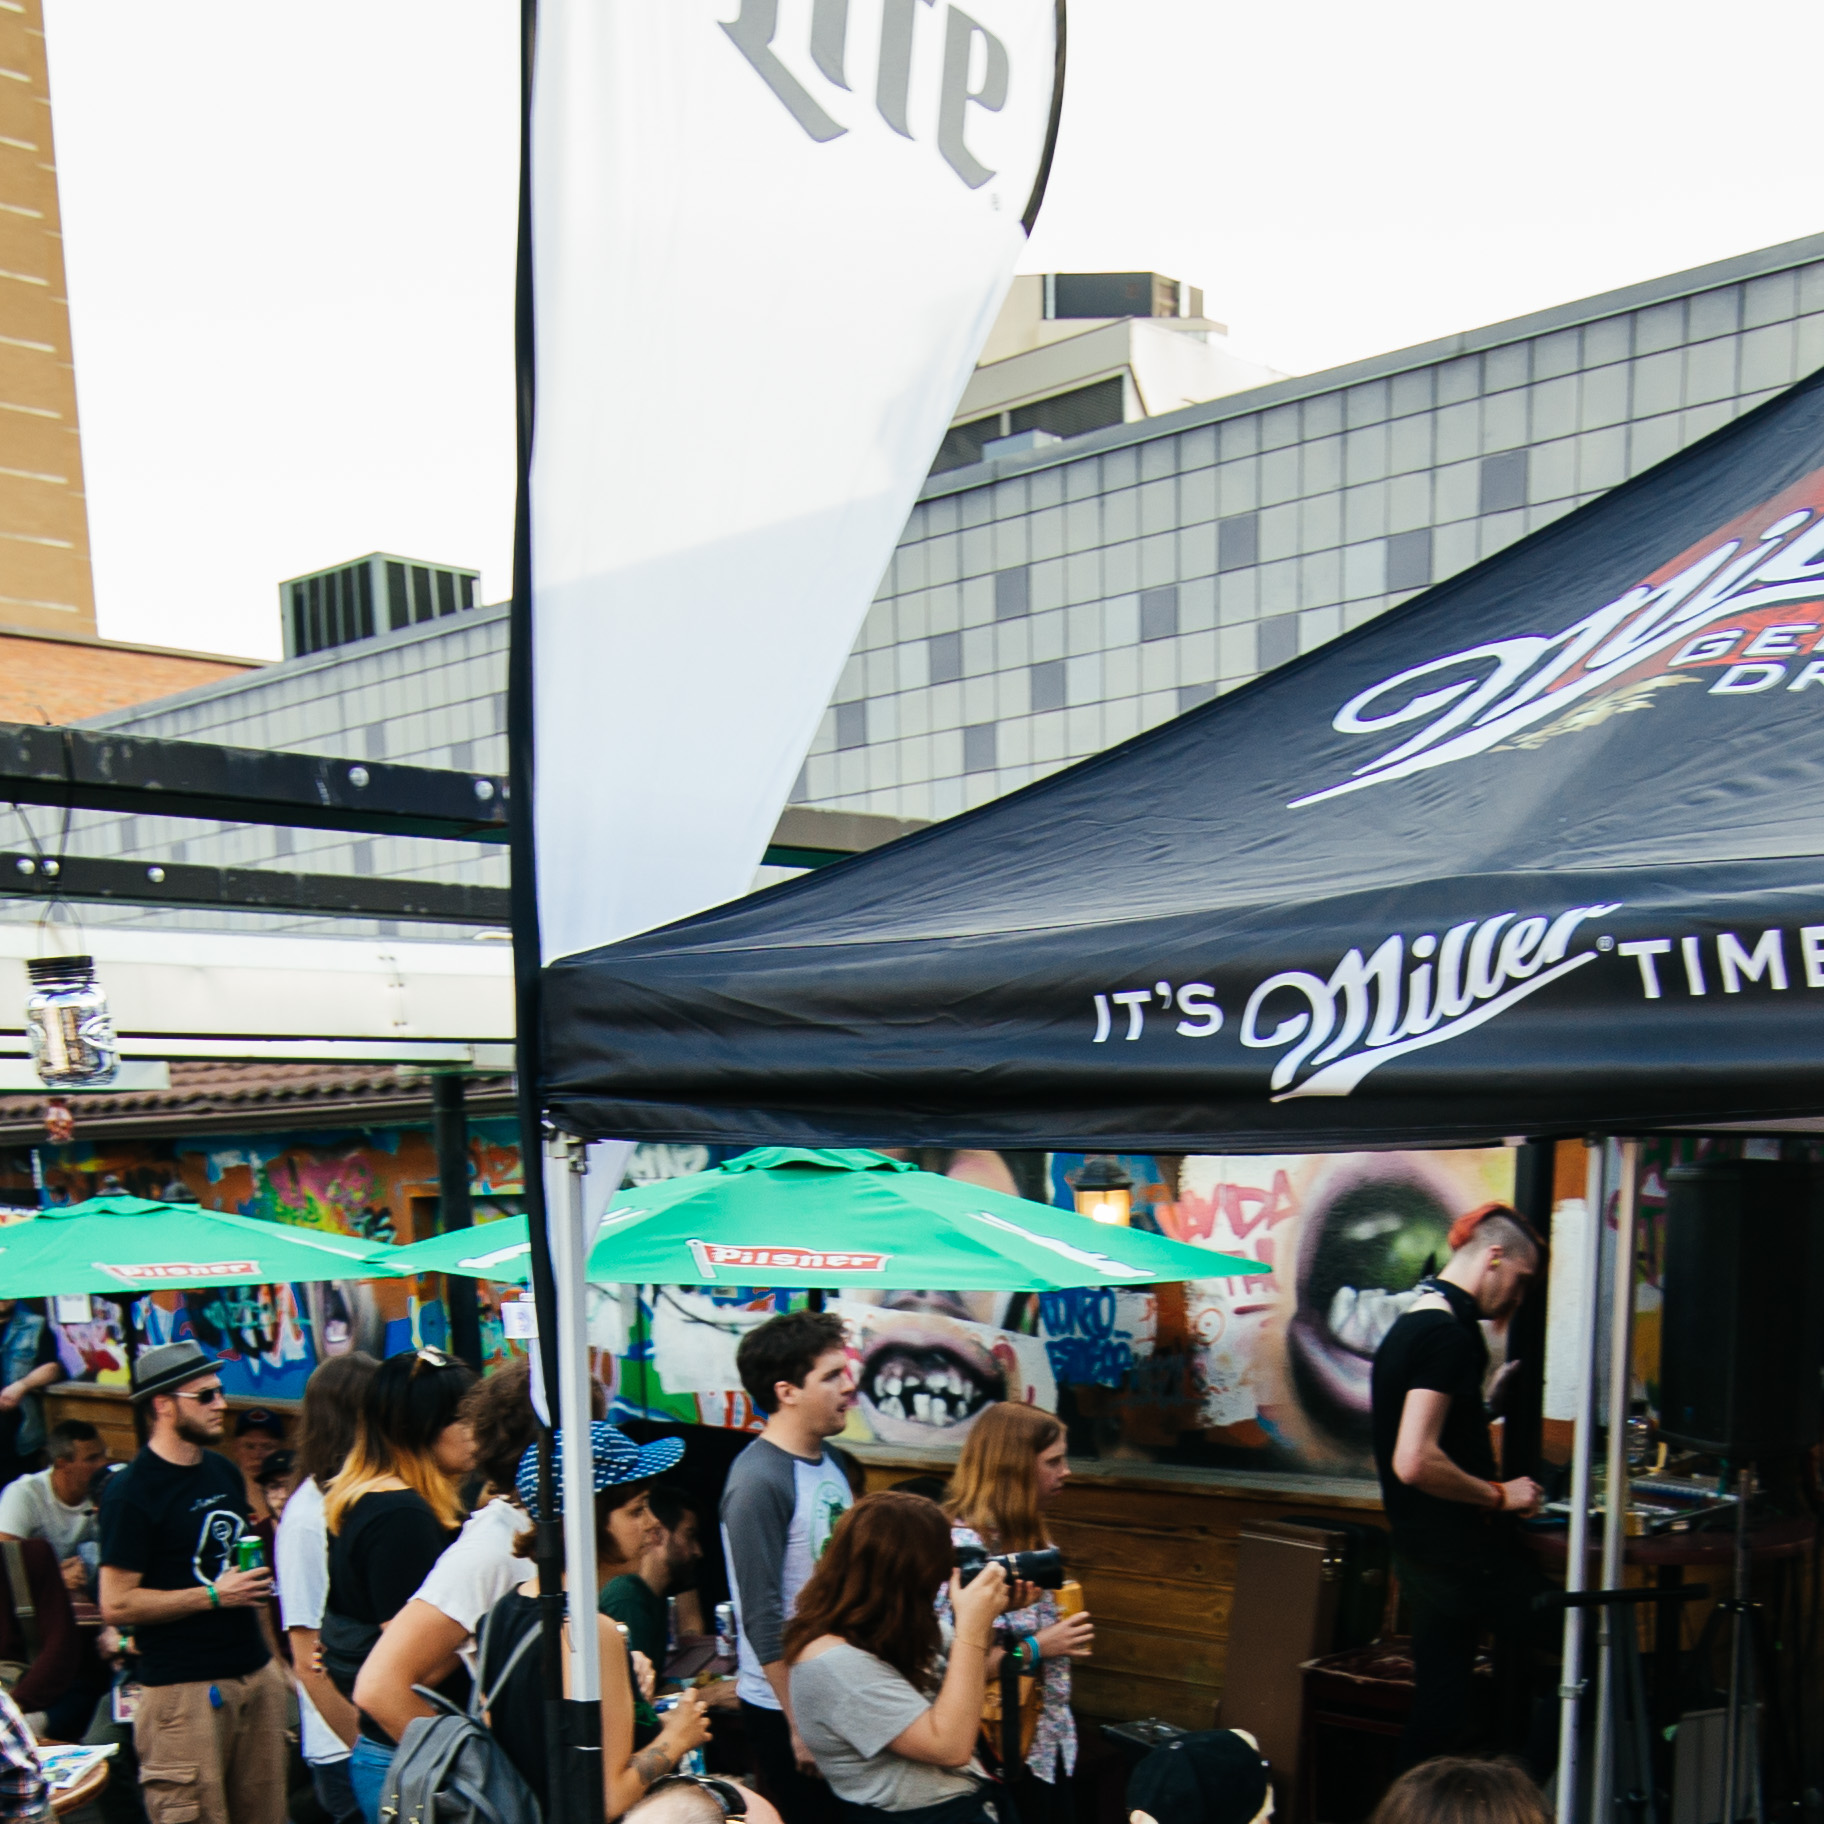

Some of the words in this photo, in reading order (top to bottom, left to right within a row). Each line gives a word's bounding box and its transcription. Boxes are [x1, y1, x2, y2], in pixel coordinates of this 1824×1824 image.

[1091, 977, 1224, 1044] IT'S
[1239, 902, 1622, 1102] Miller
[710, 1247, 878, 1267] Pilsner
[119, 1262, 249, 1277] Pilsner
